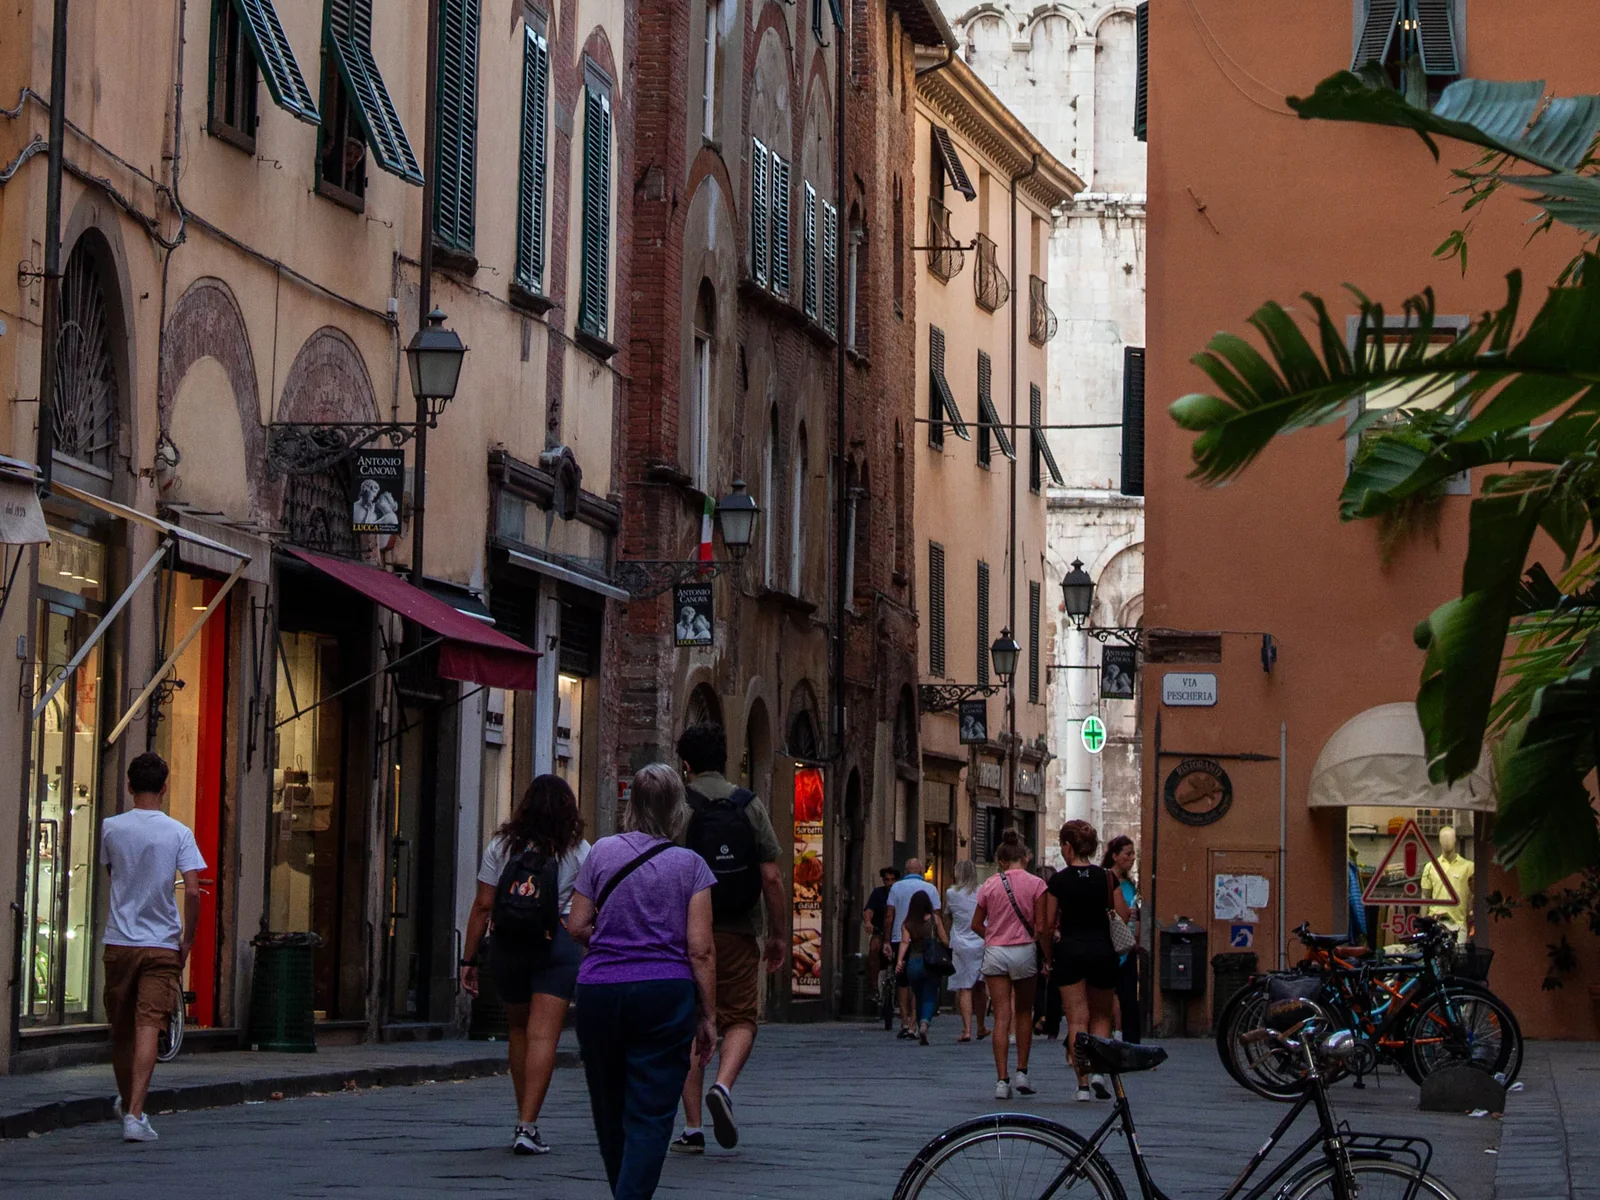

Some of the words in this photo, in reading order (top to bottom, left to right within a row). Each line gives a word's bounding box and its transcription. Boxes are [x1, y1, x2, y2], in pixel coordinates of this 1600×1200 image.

[357, 456, 401, 466] ANTONIO
[360, 465, 397, 475] CANOVA
[353, 523, 379, 532] LUCCA
[677, 589, 710, 597] ANTONIO
[1182, 678, 1197, 687] VIA
[1167, 691, 1213, 701] PESCHERIA
